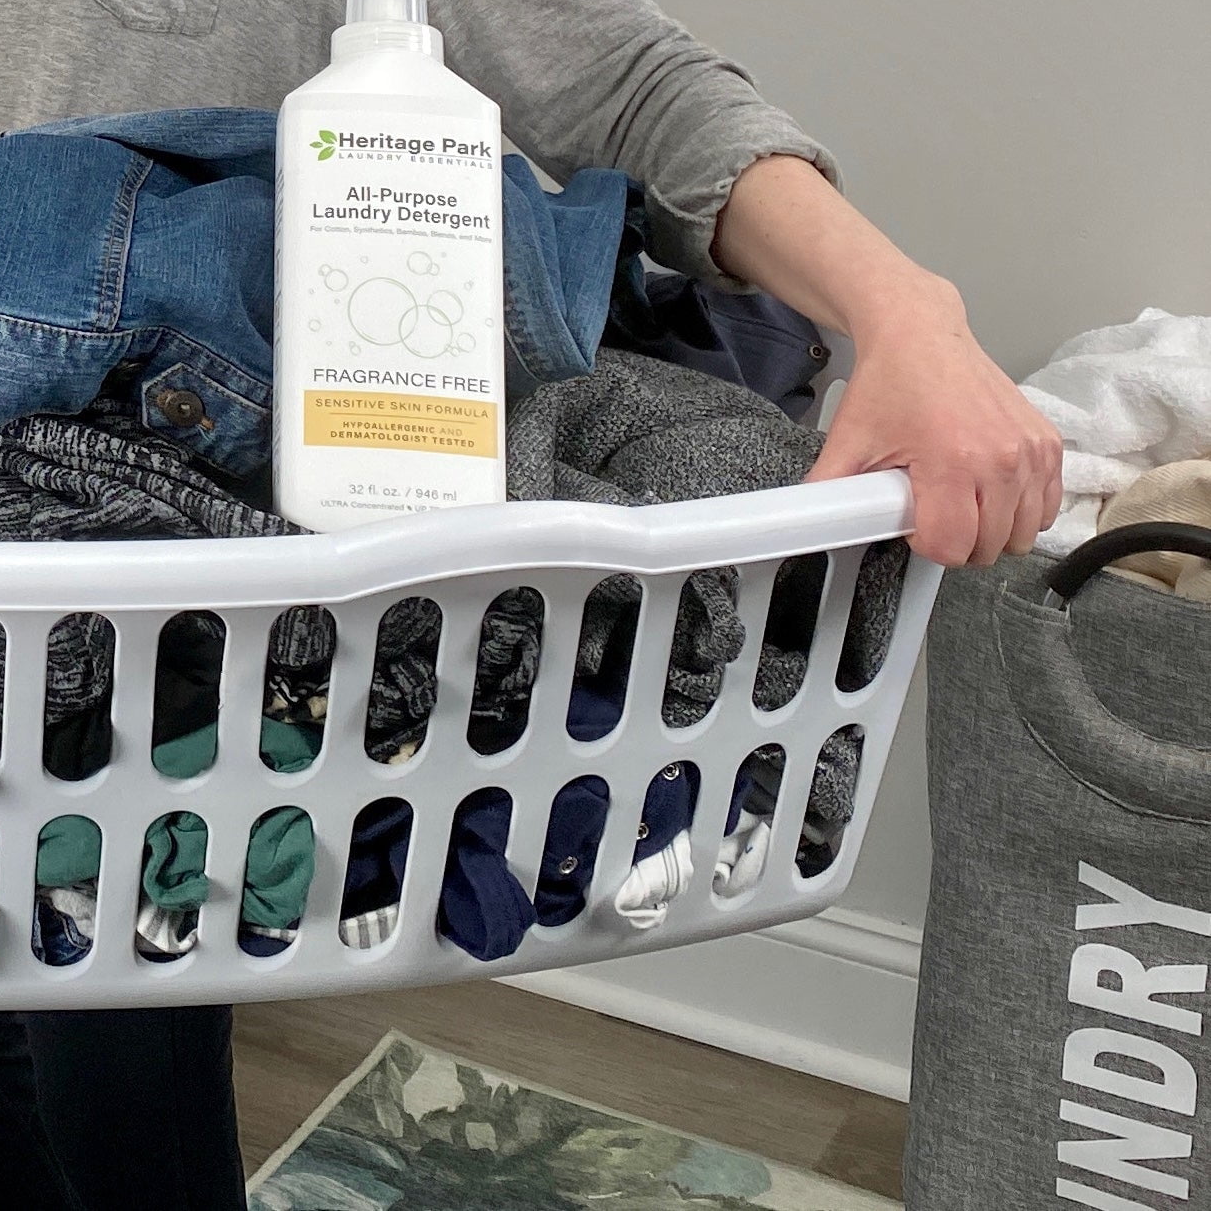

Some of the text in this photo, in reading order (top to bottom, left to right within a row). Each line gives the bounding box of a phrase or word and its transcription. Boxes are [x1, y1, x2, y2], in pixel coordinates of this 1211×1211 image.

[338, 132, 492, 158] Heritage Park
[339, 152, 493, 170] LAUNDRY ESSENTIALS
[346, 186, 458, 208] All-Purpose
[312, 203, 491, 230] Laundry Detergent
[313, 368, 491, 395] FRAGRANCE FREE
[315, 398, 489, 419] SENSITIVE SKIN FORMULA
[330, 430, 476, 448] DERMATOLOGIST TESTED
[342, 420, 463, 437] HYPOALLERGENIC AND
[348, 484, 365, 495] 32
[415, 488, 439, 500] 946
[442, 490, 458, 502] ml
